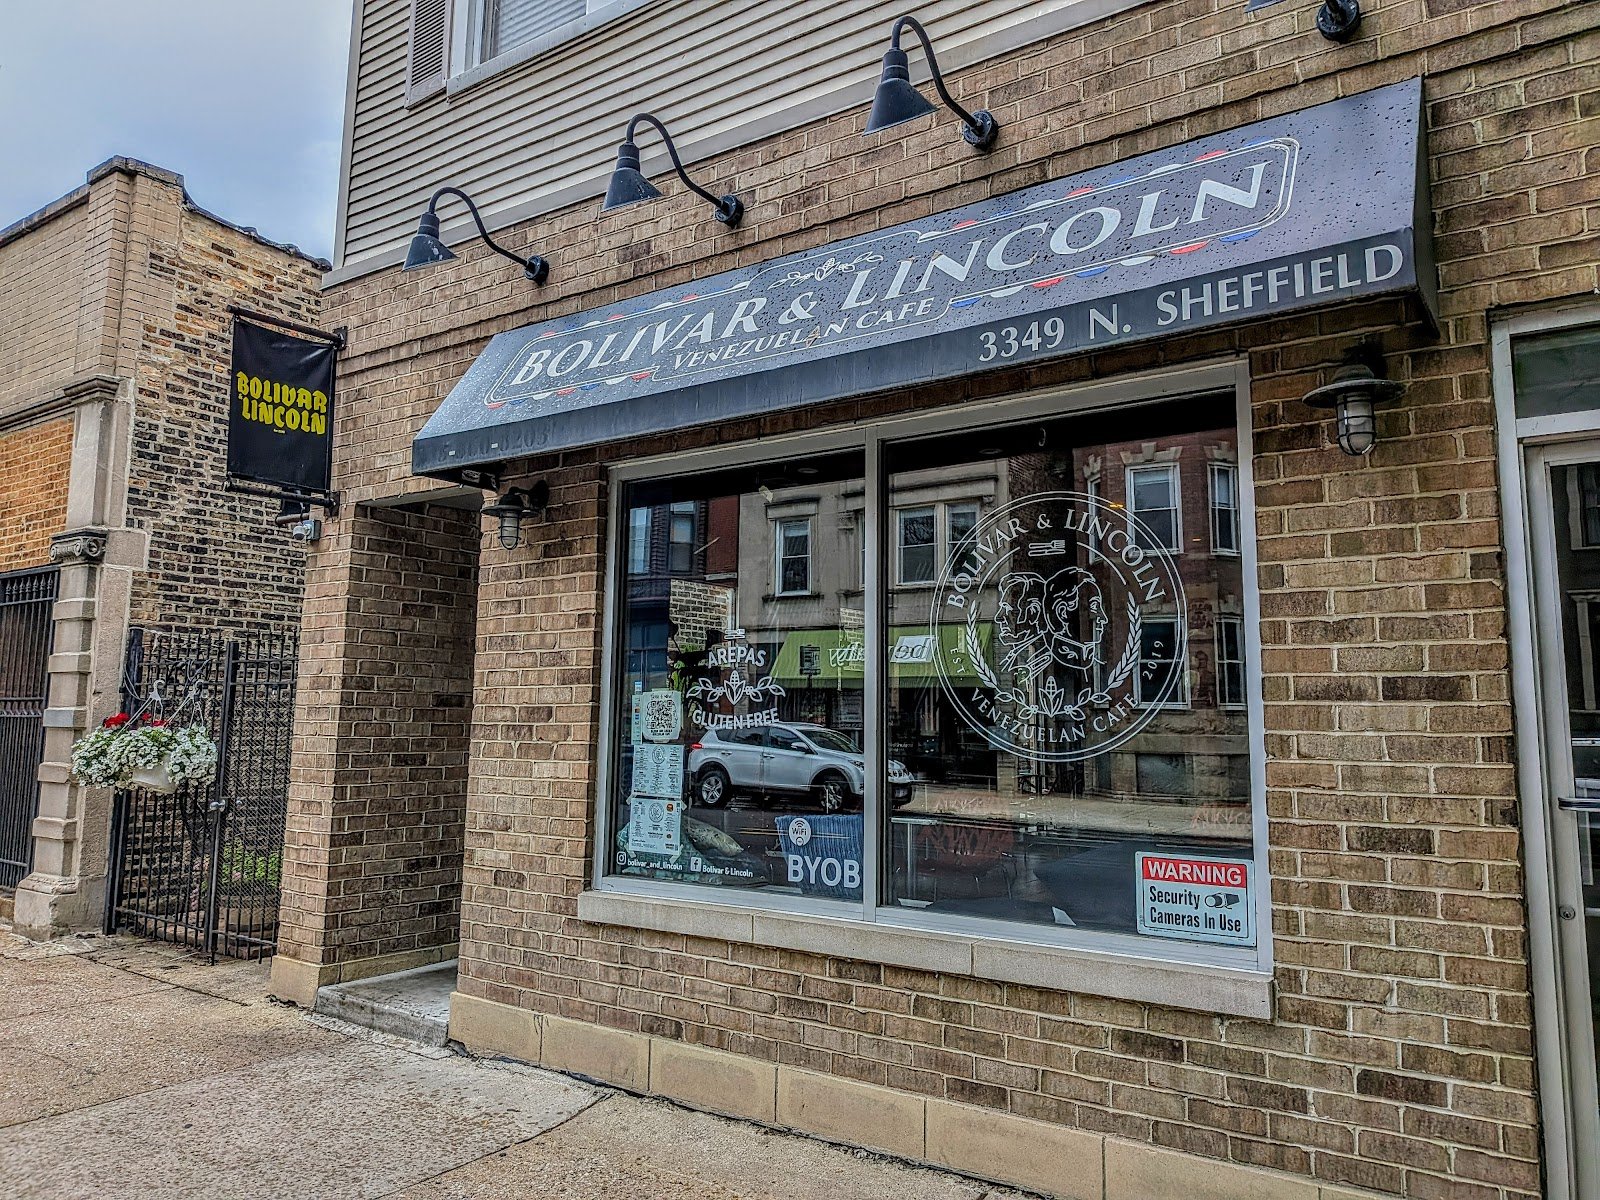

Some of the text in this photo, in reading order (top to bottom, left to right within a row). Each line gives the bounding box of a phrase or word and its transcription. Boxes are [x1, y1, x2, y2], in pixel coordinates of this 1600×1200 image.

[510, 160, 1274, 387] BOLIVAR & LINCOLN
[978, 243, 1404, 363] 3349 N. SHEFFIELD
[673, 297, 935, 371] VENEZUELAN CAFE
[236, 371, 328, 414] BOLIVAR
[241, 396, 327, 435] LINCOLN
[946, 508, 1166, 609] BOLIVAR & LINCOLN
[707, 645, 767, 669] AREPAS
[1142, 639, 1165, 681] 2019
[692, 708, 744, 730] GLUTEN
[746, 707, 780, 728] FREE
[971, 687, 1140, 744] VENEZUELAN CAFE
[702, 864, 724, 876] Bolivar
[730, 867, 754, 878] Lincoln
[787, 854, 861, 889] BYOB
[1147, 860, 1242, 885] WARNING
[1149, 885, 1201, 910] Security
[1151, 907, 1242, 932] Cameras In Use
